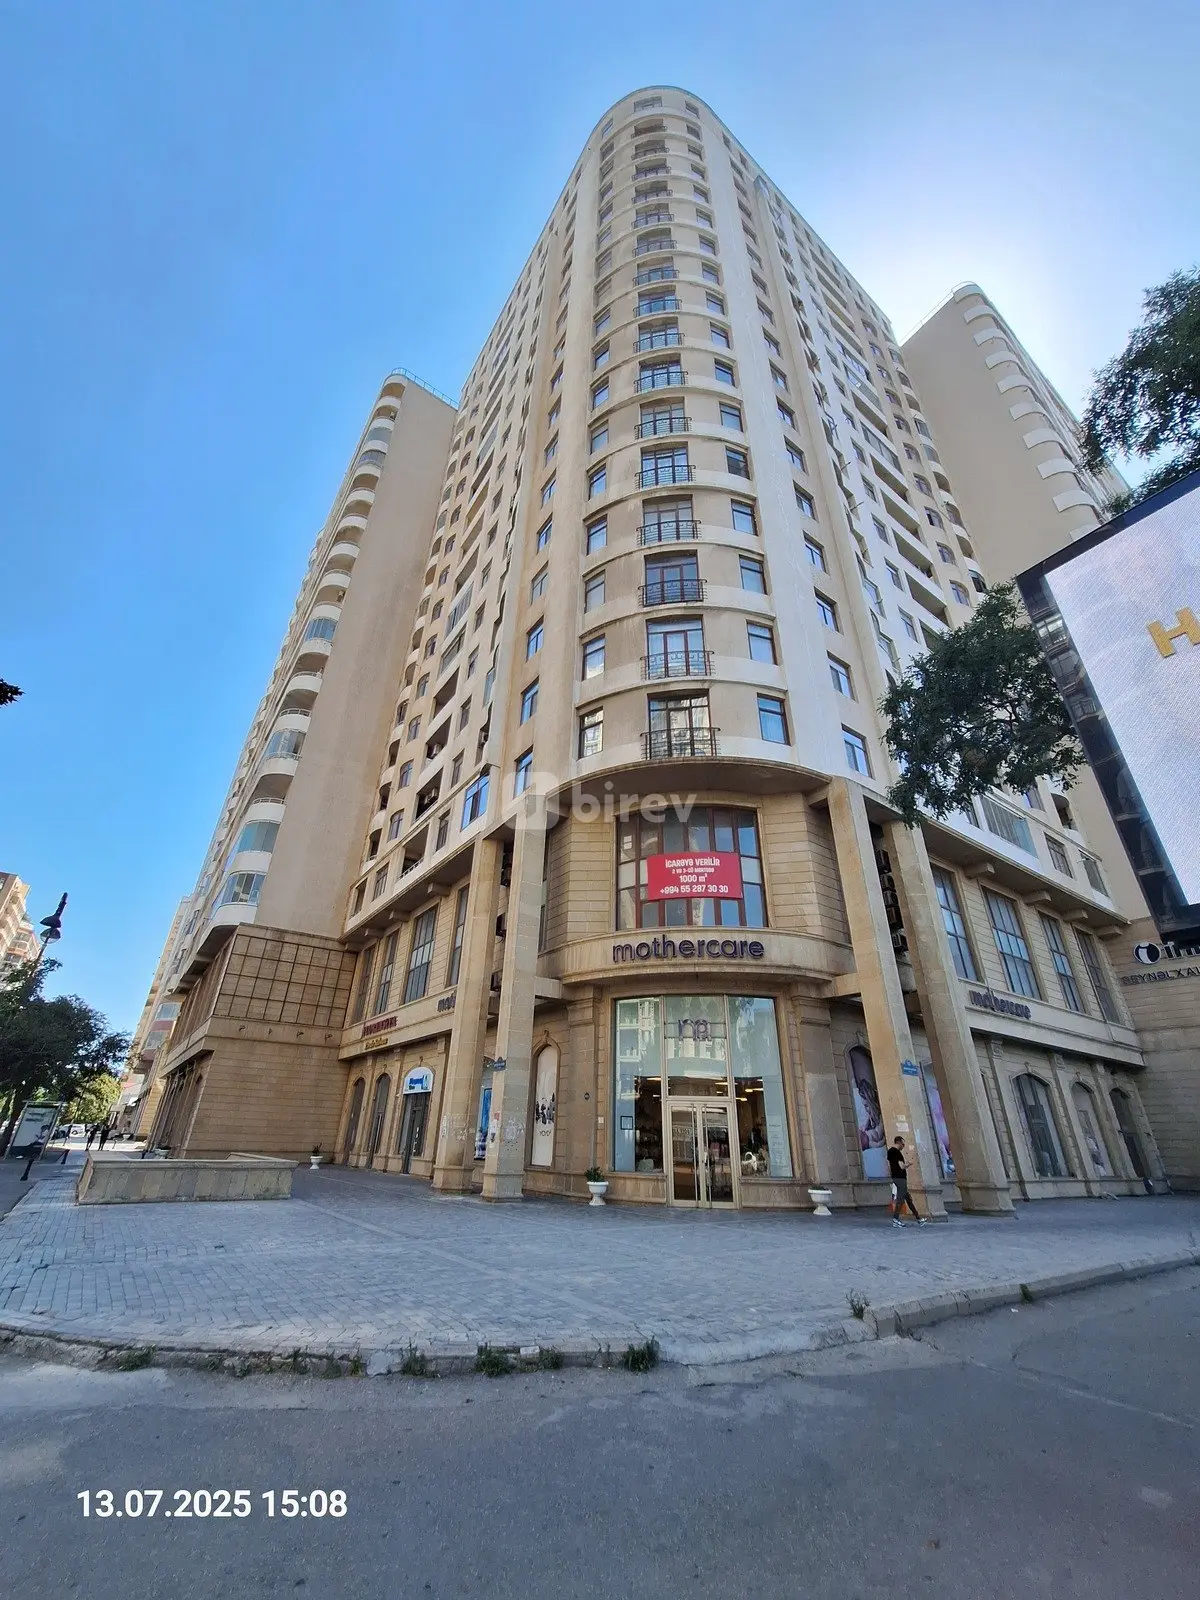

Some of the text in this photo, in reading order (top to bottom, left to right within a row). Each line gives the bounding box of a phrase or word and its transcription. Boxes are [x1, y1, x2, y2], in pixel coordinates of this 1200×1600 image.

[679, 874, 697, 883] 1000
[660, 884, 728, 894] +994 55 287 30 30
[612, 934, 765, 963] mothercare
